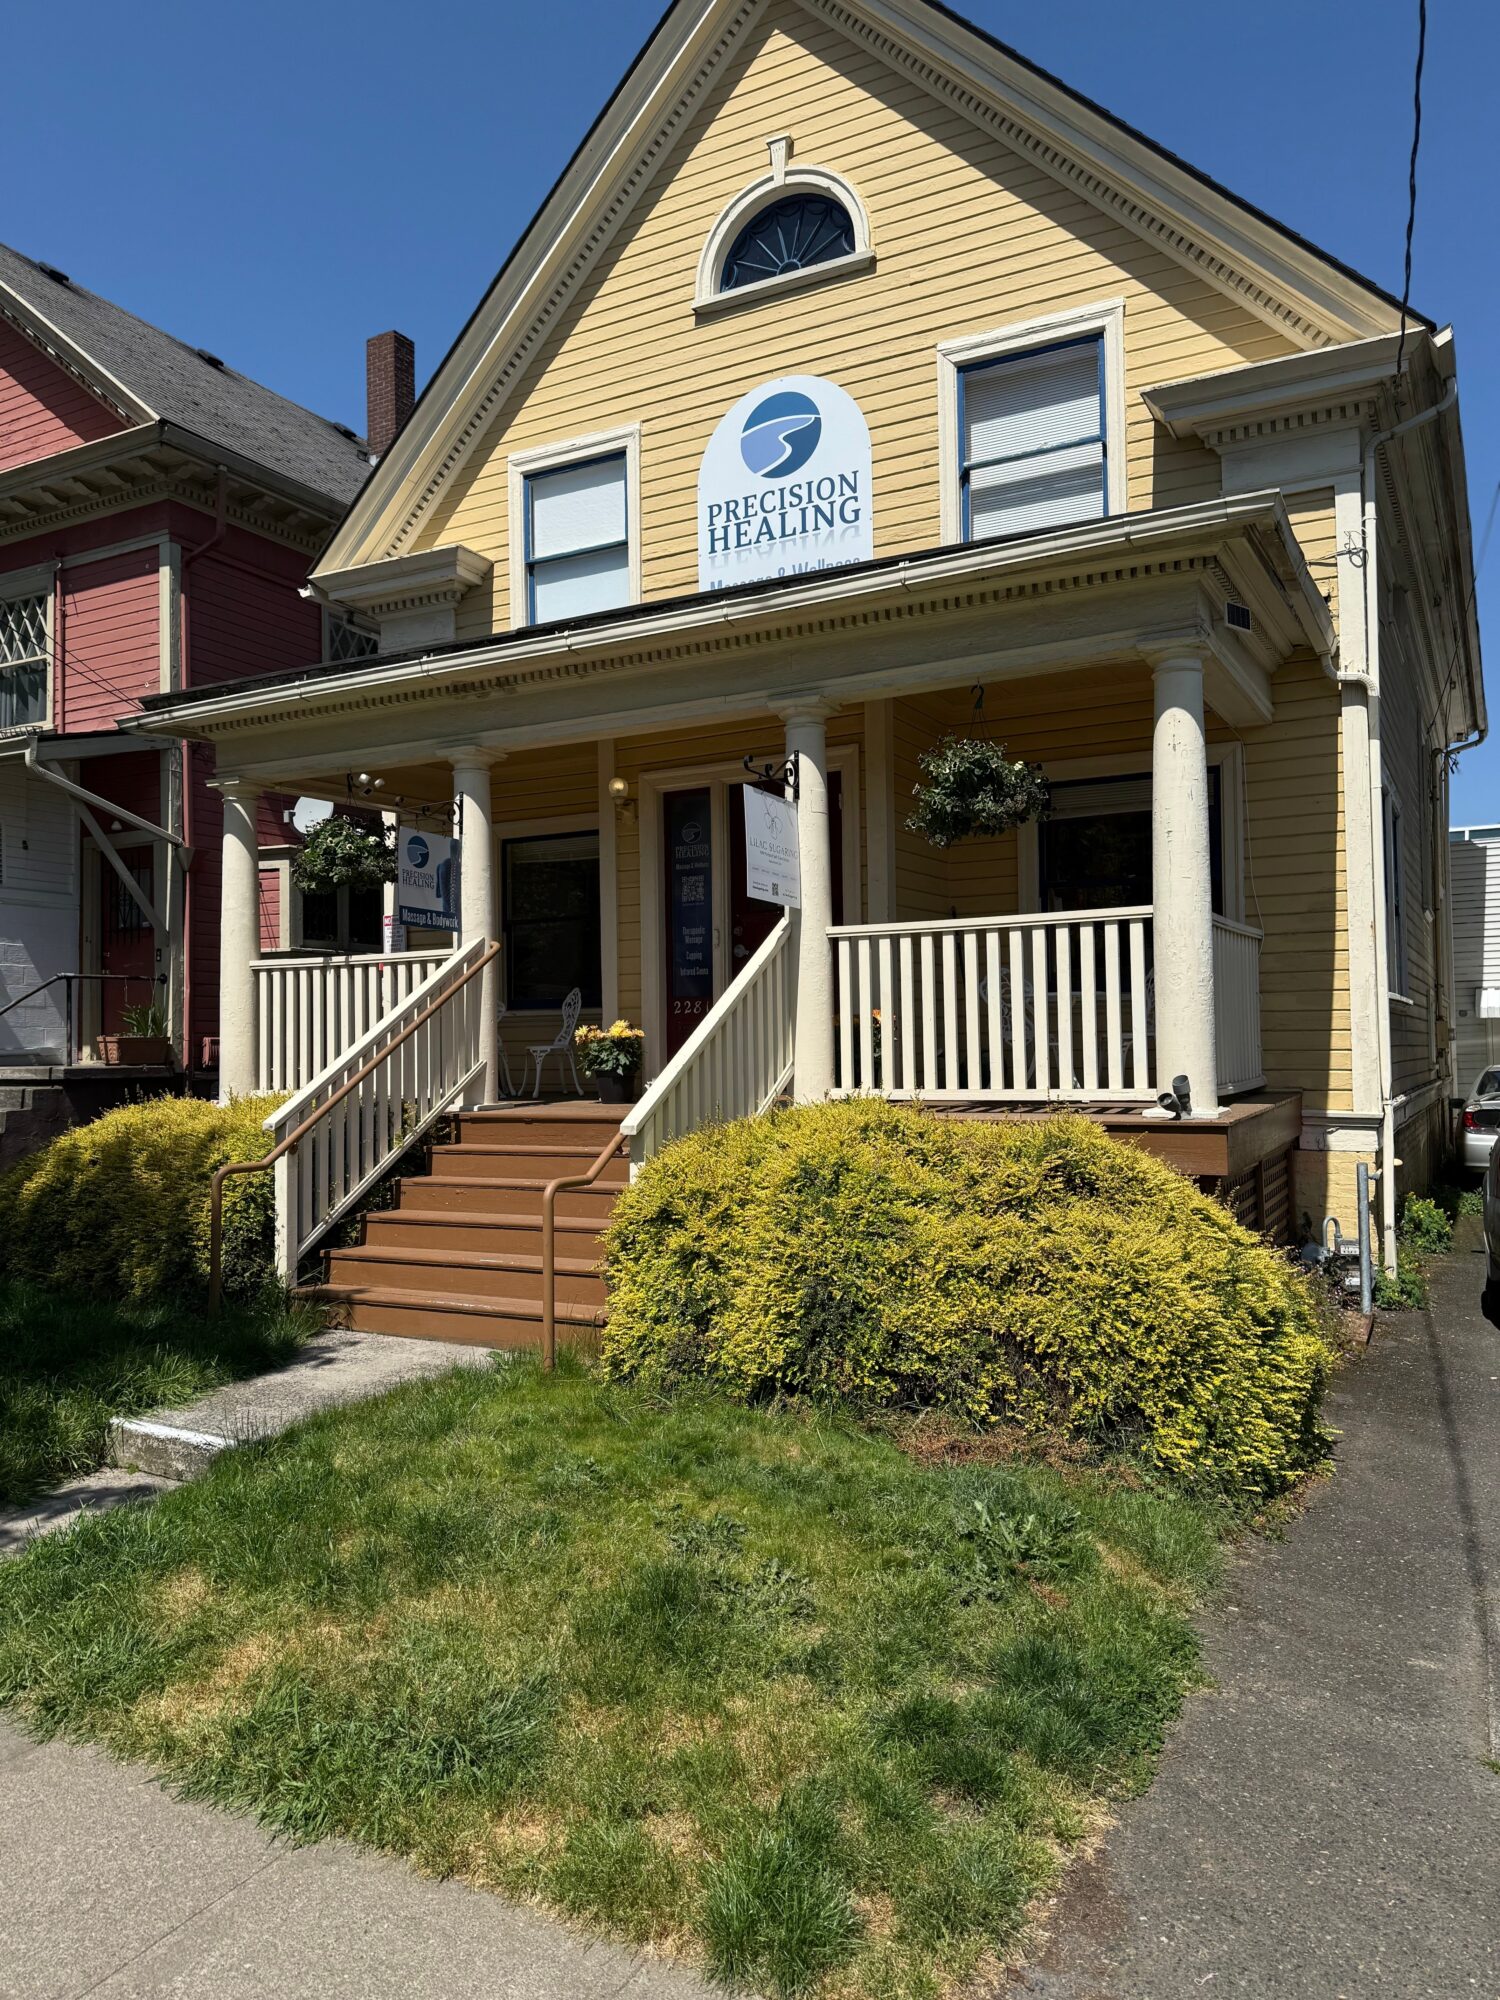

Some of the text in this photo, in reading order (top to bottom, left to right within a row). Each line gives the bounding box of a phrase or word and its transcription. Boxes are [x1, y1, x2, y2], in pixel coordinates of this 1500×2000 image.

[707, 470, 859, 527] PRECISION
[708, 496, 861, 555] HEALING
[675, 849, 709, 859] HEALING
[750, 837, 767, 850] LILAC
[769, 842, 798, 859] SUGARING
[402, 869, 433, 880] PRECISION
[402, 875, 435, 889] HEALING
[402, 909, 458, 928] Massage & Bodywork
[686, 951, 702, 961] Cupping
